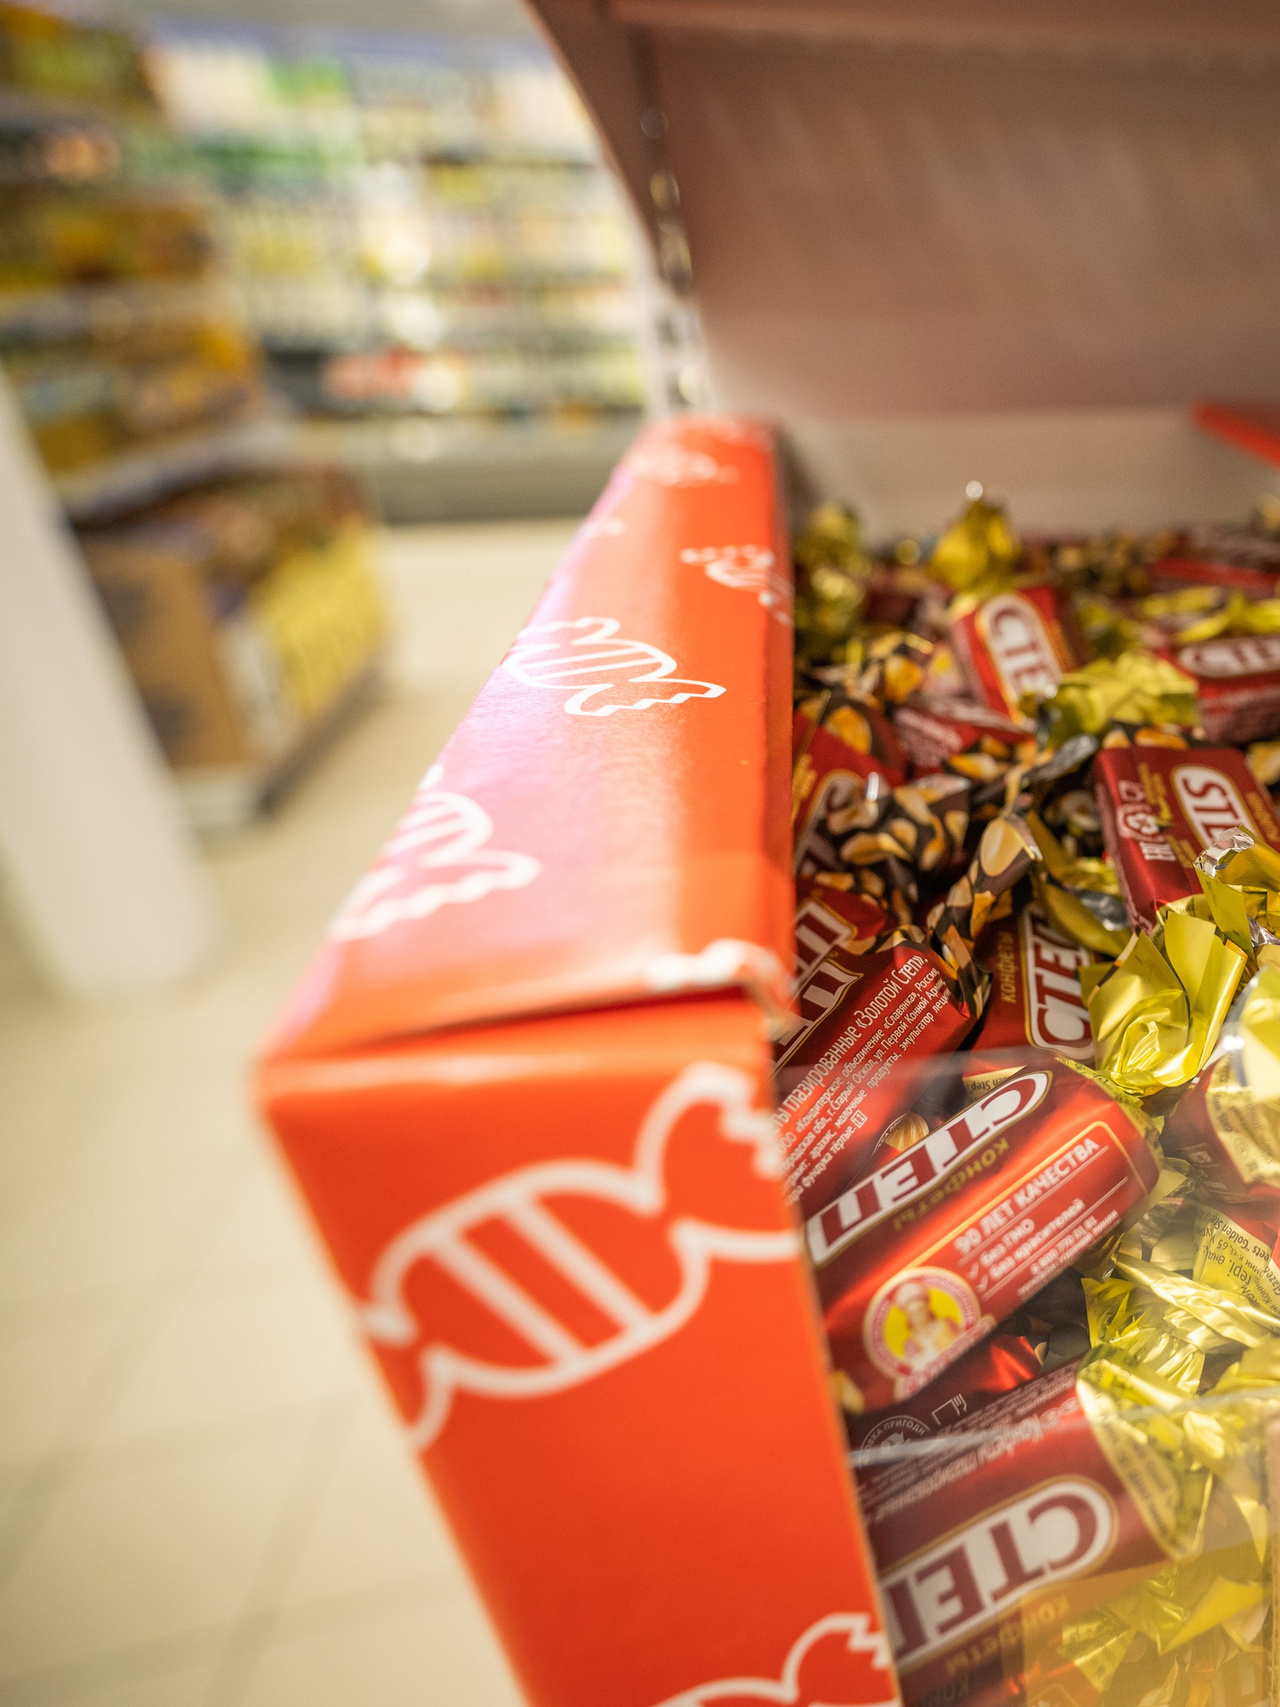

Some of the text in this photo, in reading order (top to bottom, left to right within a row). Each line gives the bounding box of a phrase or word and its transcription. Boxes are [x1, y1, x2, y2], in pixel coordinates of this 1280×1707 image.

[988, 600, 1051, 691] СТЕ
[781, 1023, 864, 1113] глазированные
[849, 976, 903, 1031] «Золотой
[889, 950, 929, 986] Степ».
[793, 1075, 845, 1134] «Кондитерское
[840, 1028, 886, 1078] объединение
[880, 989, 921, 1031] «Славянка»,
[808, 1011, 936, 1161] арахис, молочные продукты, эмульгатор
[829, 1081, 857, 1111] Старый
[851, 1056, 879, 1085] Оскол,
[872, 1046, 887, 1062] ул.
[880, 1019, 910, 1050] Первой
[902, 995, 930, 1024] Конной
[811, 1070, 1043, 1248] СТЕП
[827, 1122, 857, 1155] тёртые.
[951, 1133, 1100, 1257] 90 ЛЕТ КАЧЕСТВА
[976, 1240, 1007, 1268] без
[1000, 1215, 1037, 1249] ГМО
